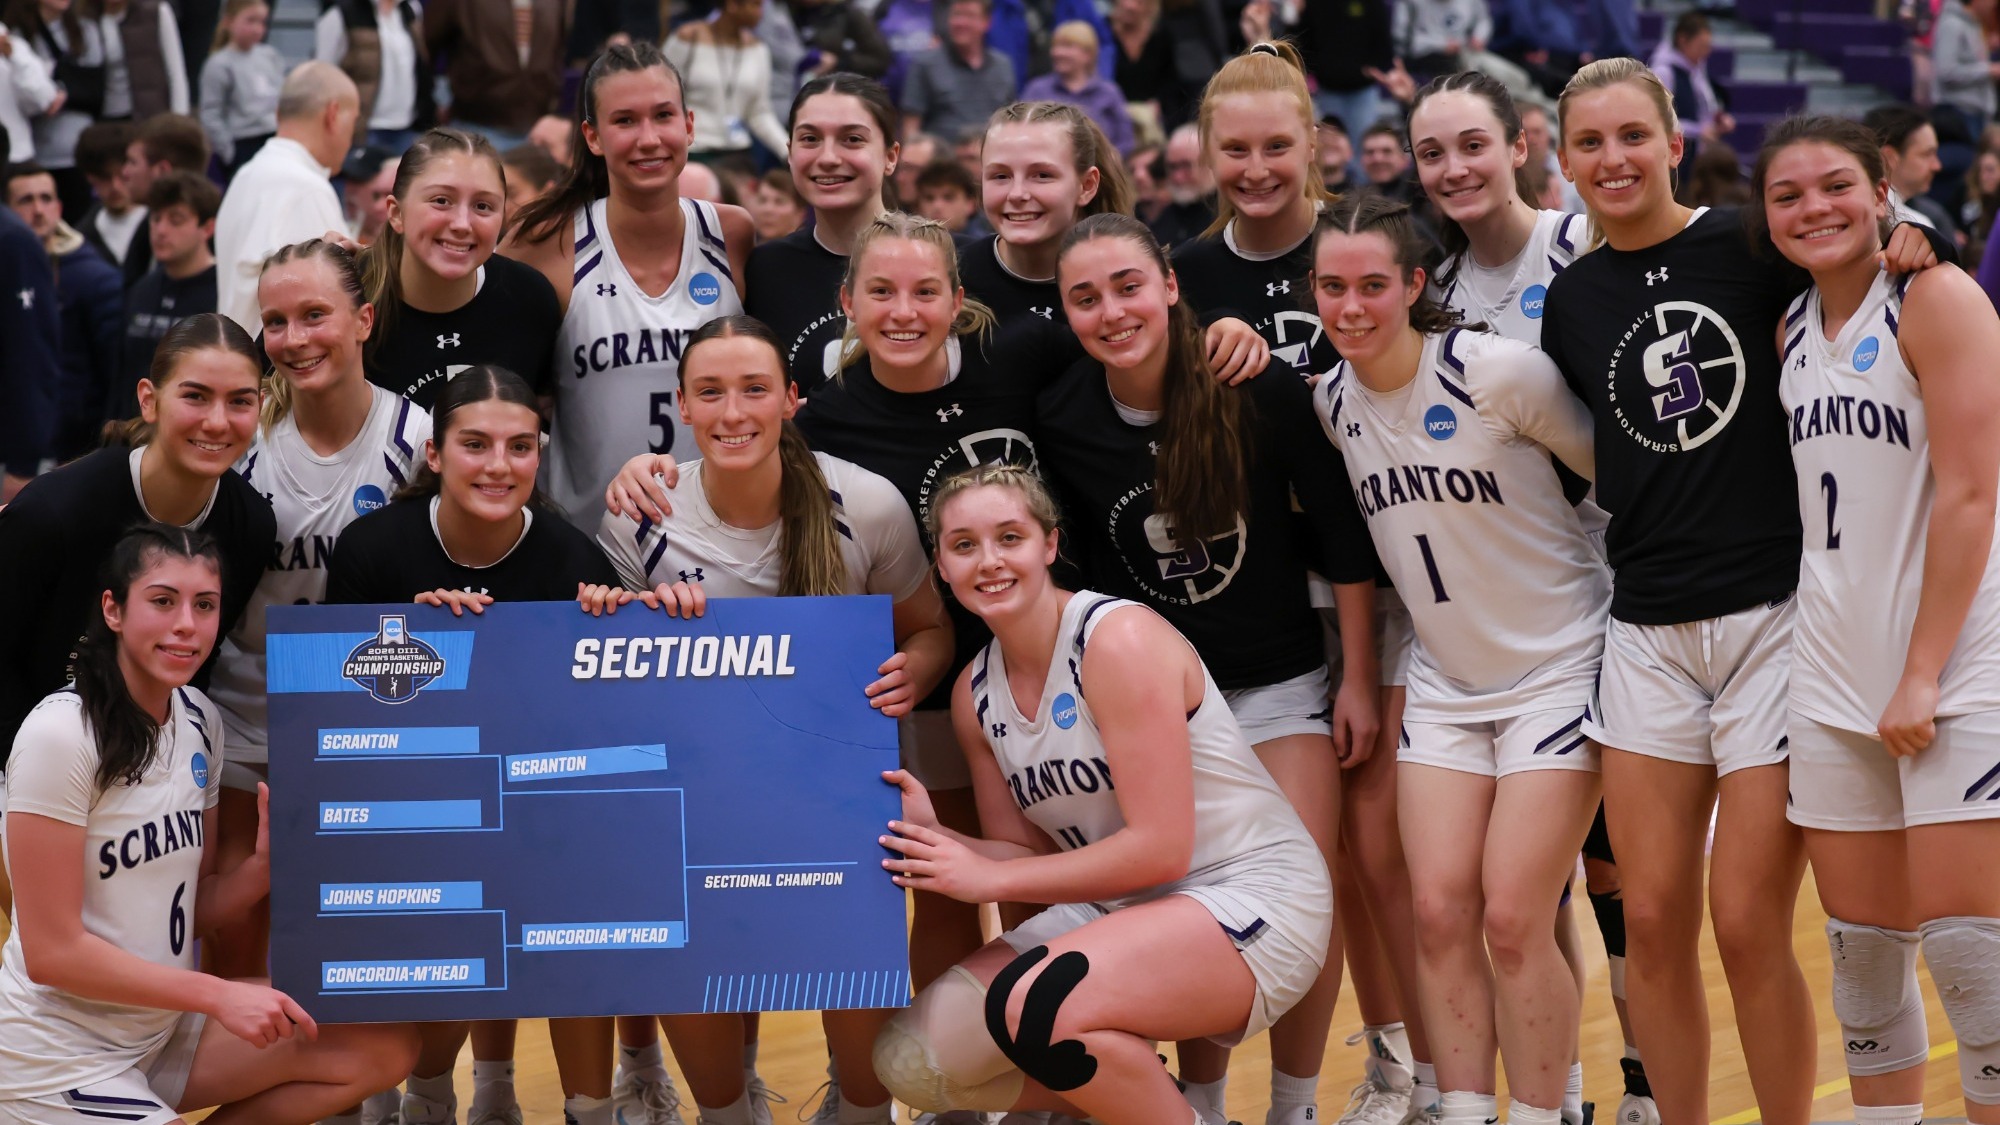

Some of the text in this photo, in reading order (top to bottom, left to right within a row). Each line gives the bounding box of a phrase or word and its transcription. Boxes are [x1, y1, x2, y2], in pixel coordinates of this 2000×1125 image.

[693, 287, 718, 296] NCAA
[1524, 299, 1544, 311] NCA
[788, 309, 844, 368] SKETBALL
[1608, 310, 1652, 402] BASKETBALL
[648, 392, 675, 455] 5
[1428, 420, 1455, 432] NCAA
[1614, 407, 1678, 453] SCRANTON
[1789, 395, 1912, 451] RANTON
[1821, 471, 1841, 550] 2
[1412, 533, 1452, 604] 1
[367, 647, 395, 655] 2026
[571, 634, 796, 680] SECTIONAL
[345, 661, 442, 676] CHAMPIONSHIP
[1056, 706, 1077, 723] NCAA
[322, 733, 400, 750] SCRANTON
[510, 755, 587, 777] SCRANTON
[1008, 756, 1115, 811] RANTON
[323, 807, 370, 824] BATES
[99, 809, 205, 881] SCRANT
[704, 872, 844, 889] SECTIONAL CHAMPION
[323, 888, 442, 906] JOHNS HOPKINS
[169, 881, 186, 957] 6
[526, 927, 669, 946] CONCORDIA-M'HEAD
[326, 964, 470, 983] CONCORDIA-M'HEAD
[1305, 1107, 1314, 1121] S
